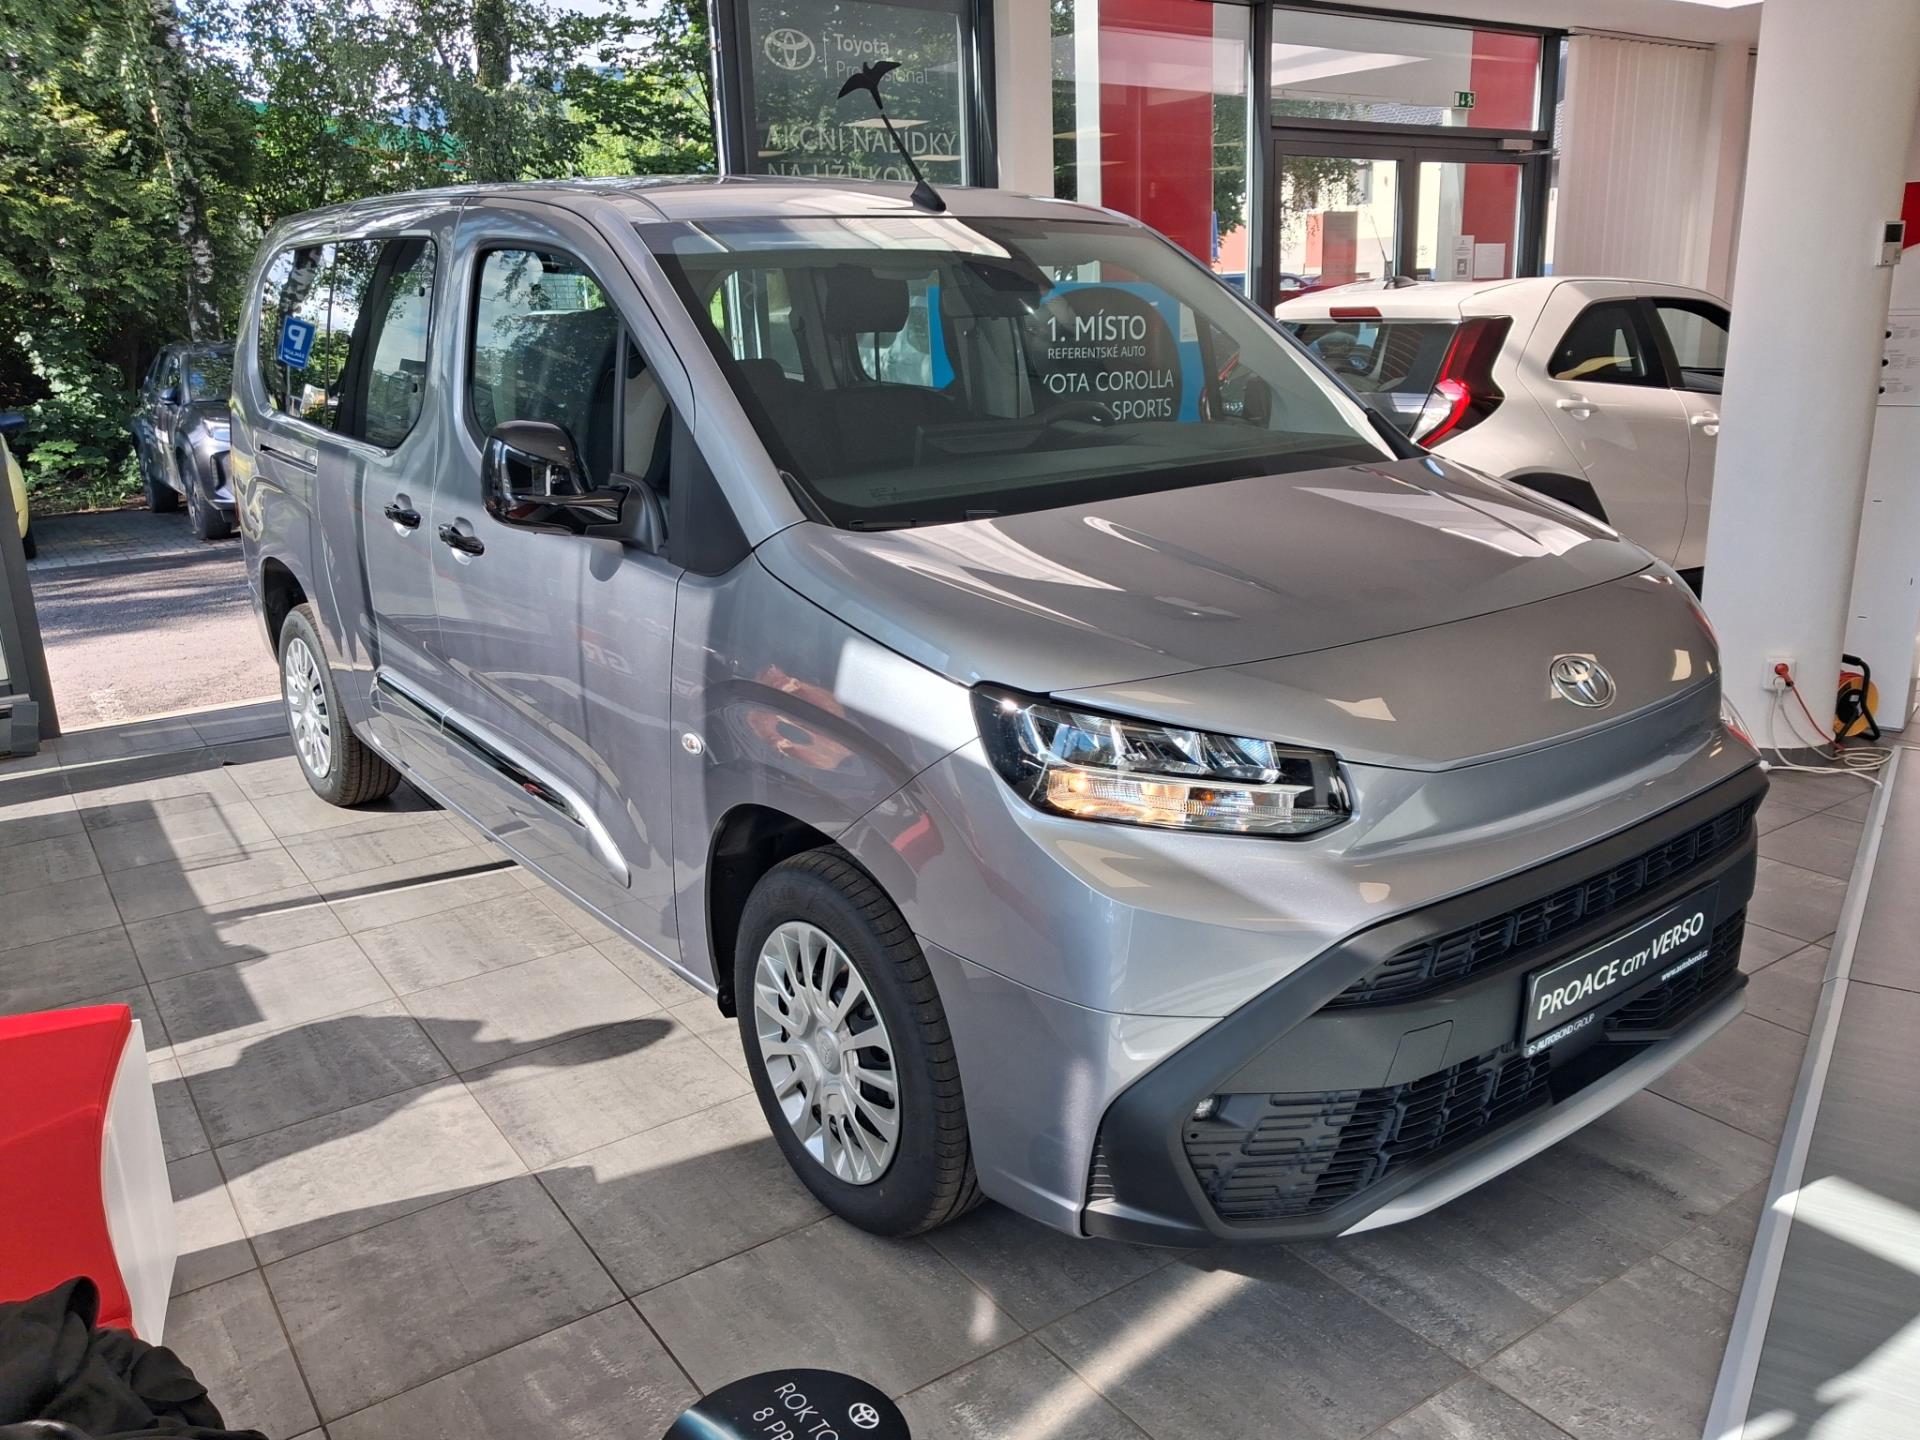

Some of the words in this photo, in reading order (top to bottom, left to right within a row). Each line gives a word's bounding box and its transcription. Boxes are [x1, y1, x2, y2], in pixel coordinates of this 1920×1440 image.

[833, 33, 889, 57] Toyota
[836, 60, 928, 85] Prosional
[765, 119, 844, 152] AKČNÍ
[1046, 316, 1066, 343] 1.
[1075, 309, 1146, 342] MÍSTO
[1047, 344, 1118, 360] REFERENTSKÉ
[1120, 345, 1146, 358] AUTO
[1042, 373, 1090, 394] OTA
[1095, 368, 1174, 392] COROLLA
[1112, 397, 1172, 421] SPORTS
[1536, 959, 1620, 1021] PROACE
[1621, 947, 1651, 977] CITY
[1652, 911, 1704, 960] VERSO
[1536, 1025, 1573, 1051] AUTOBOND
[1573, 1013, 1595, 1031] GROUP
[752, 1407, 775, 1422] 8
[774, 1382, 819, 1423] ROK
